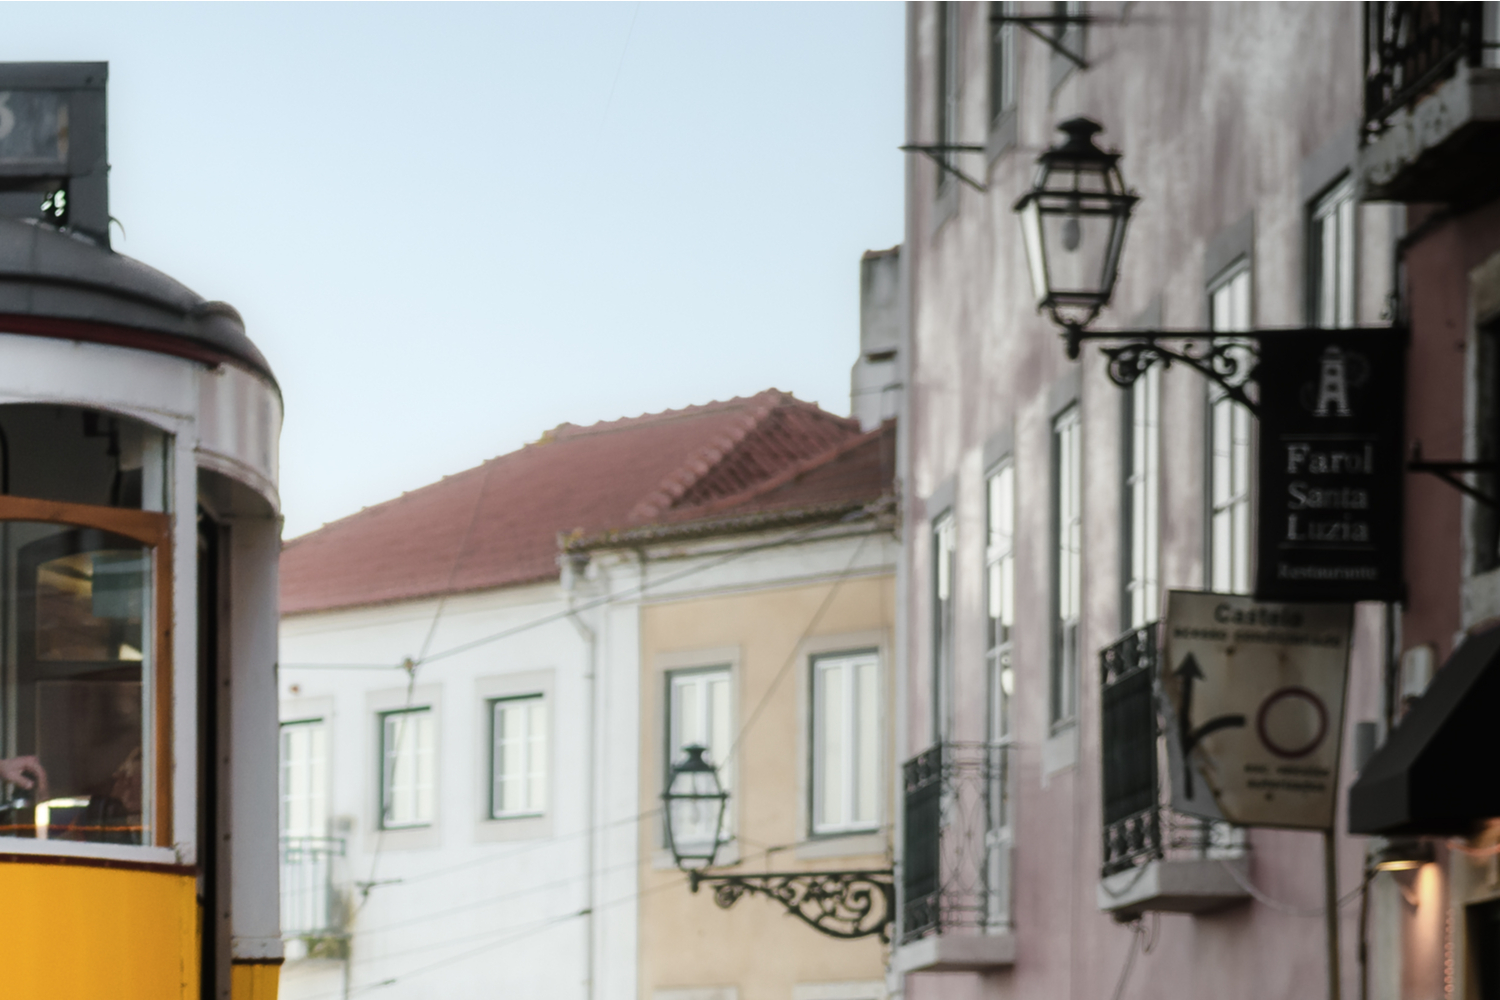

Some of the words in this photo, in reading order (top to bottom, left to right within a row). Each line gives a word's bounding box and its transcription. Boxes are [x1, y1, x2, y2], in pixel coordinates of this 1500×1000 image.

[1287, 443, 1373, 474] Farol
[1287, 480, 1368, 510] Santa
[1287, 513, 1369, 541] Luzia
